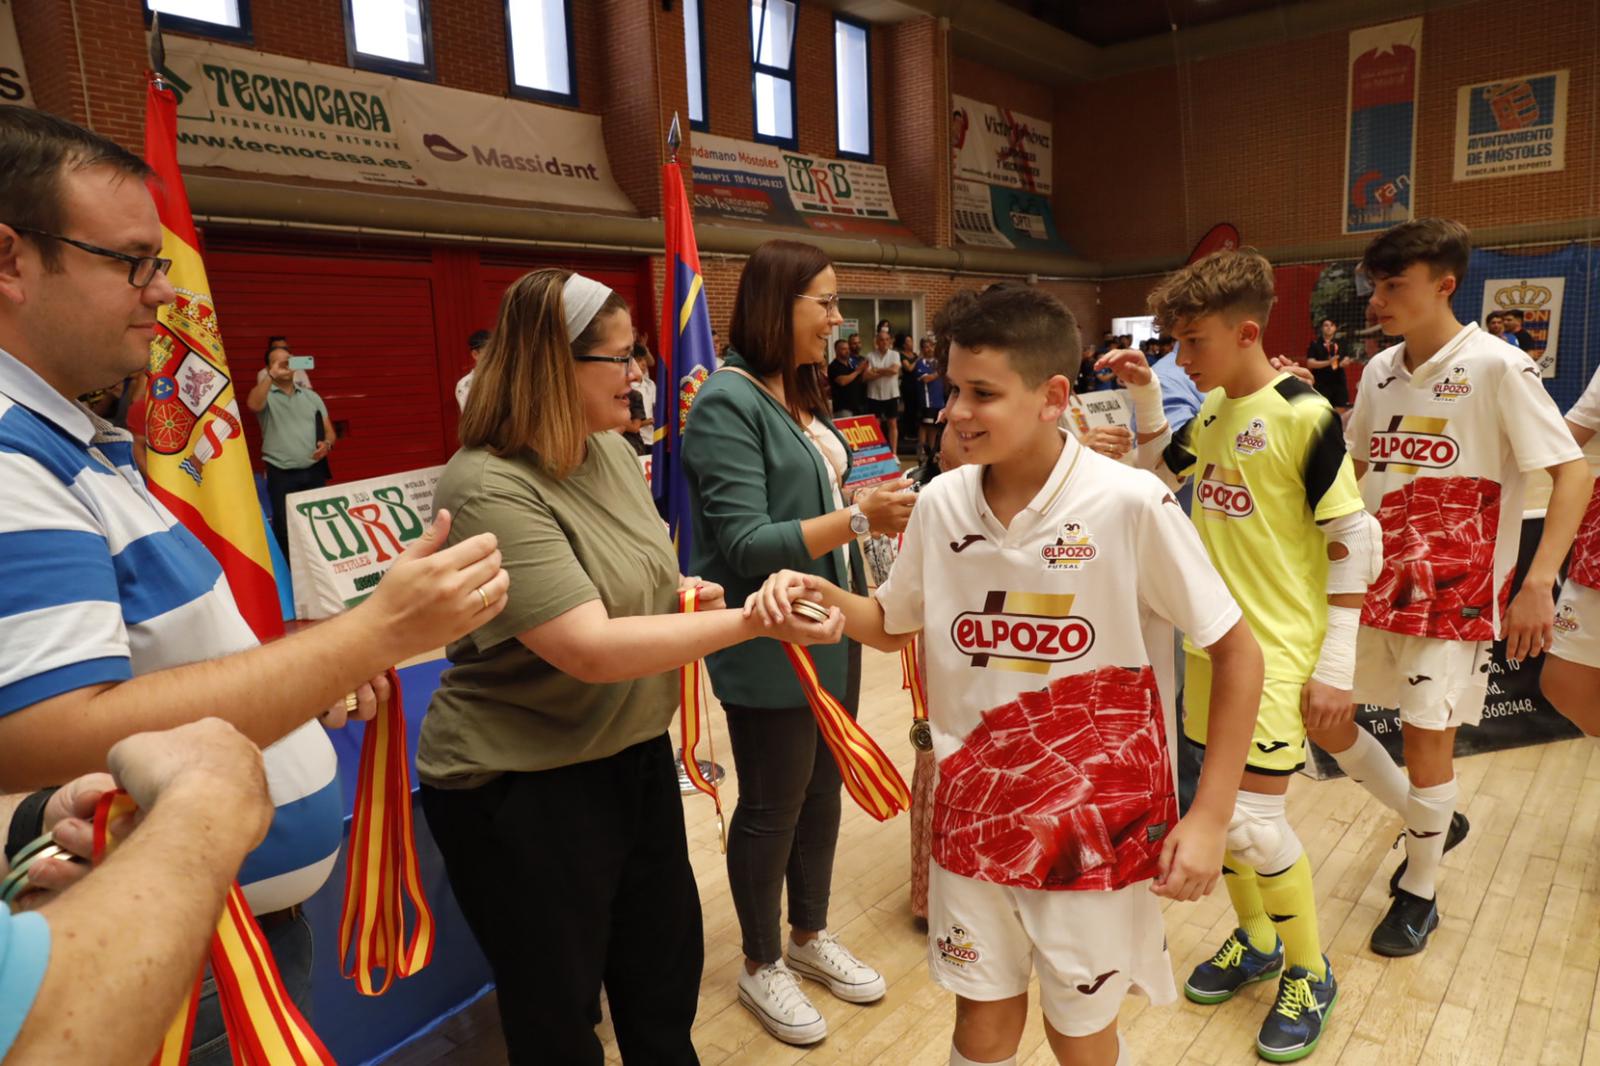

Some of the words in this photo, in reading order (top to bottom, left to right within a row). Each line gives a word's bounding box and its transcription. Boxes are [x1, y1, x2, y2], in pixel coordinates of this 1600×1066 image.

[177, 131, 413, 170] ww.tecnocasa.es
[220, 116, 326, 140] FRANCHISING
[335, 134, 401, 151] NETWORK
[1369, 718, 1392, 734] Tel.
